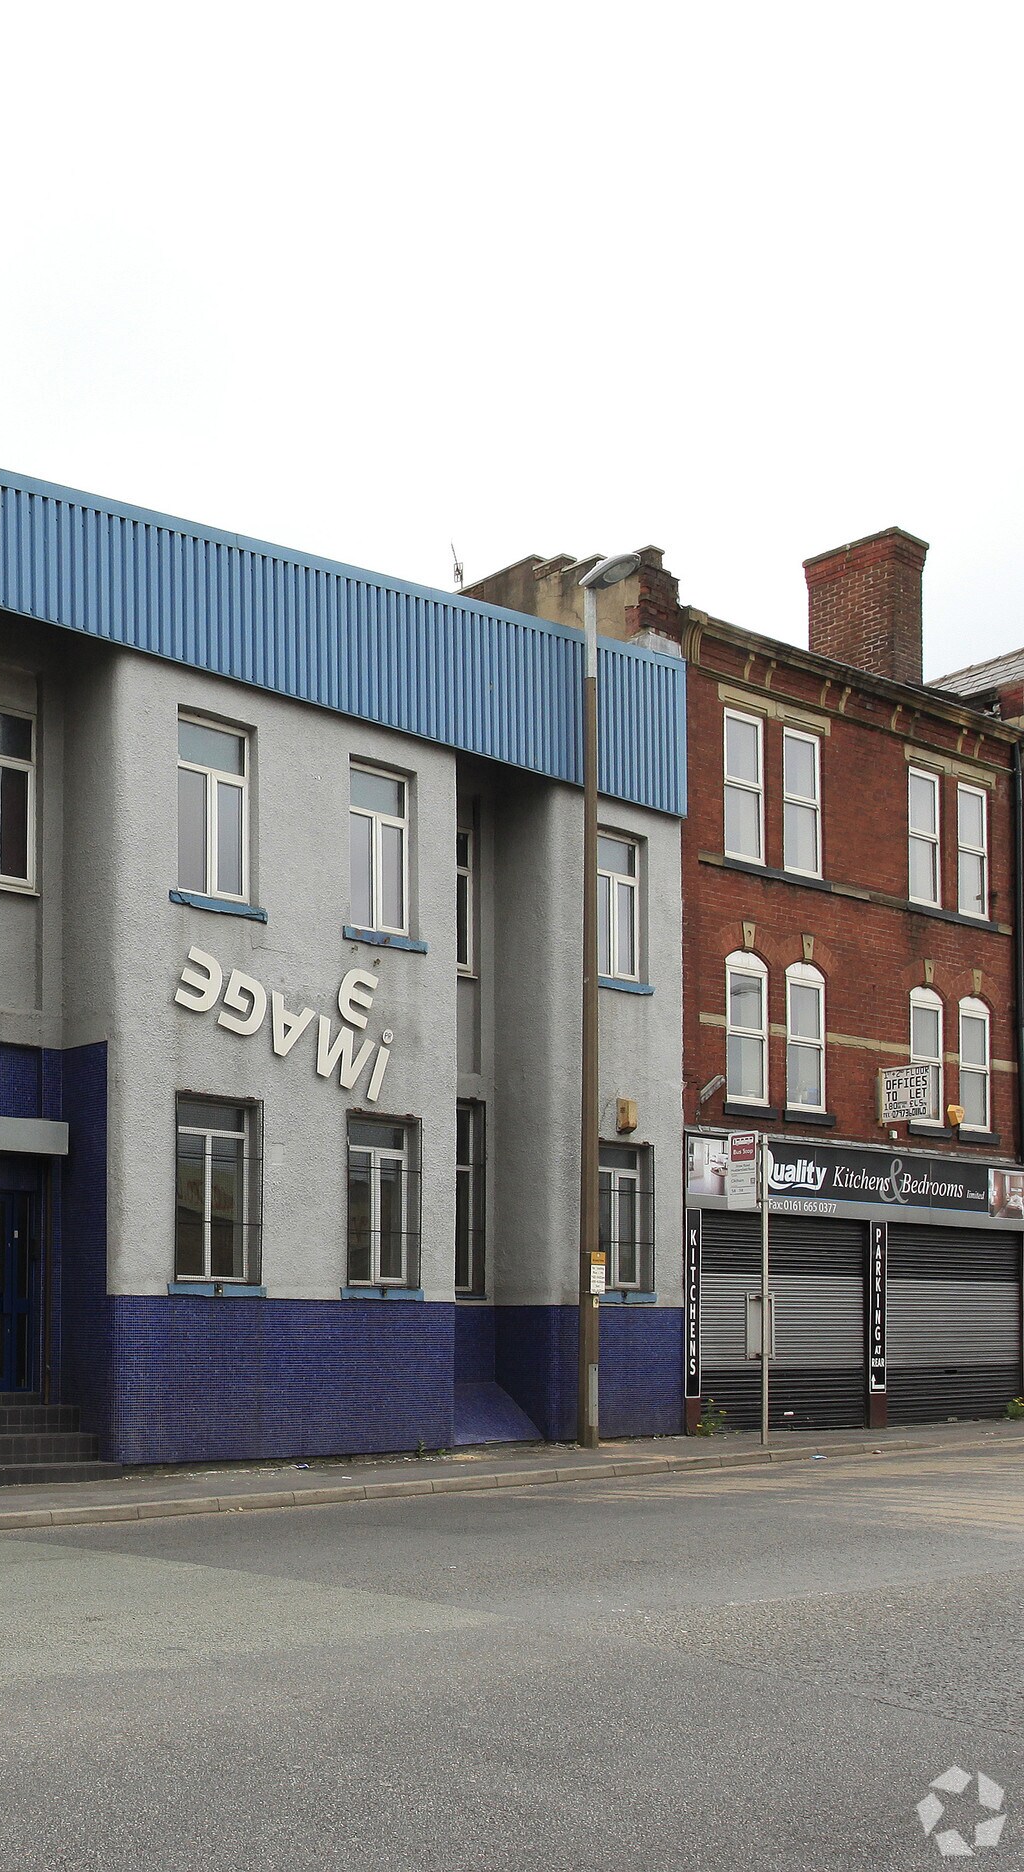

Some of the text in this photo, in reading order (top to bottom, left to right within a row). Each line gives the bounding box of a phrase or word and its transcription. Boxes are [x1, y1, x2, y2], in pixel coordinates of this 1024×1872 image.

[886, 1076, 927, 1090] OFFICES
[886, 1087, 927, 1101] TO LET
[832, 1165, 891, 1192] Kitchens
[879, 1158, 910, 1204] &
[902, 1173, 964, 1198] Bedrooms
[966, 1189, 986, 1200] limited
[784, 1200, 802, 1211] 0161
[803, 1201, 818, 1212] 665
[818, 1202, 837, 1213] 0377
[689, 1229, 697, 1376] KITCHENS
[874, 1345, 882, 1355] AT
[871, 1357, 885, 1368] REAR
